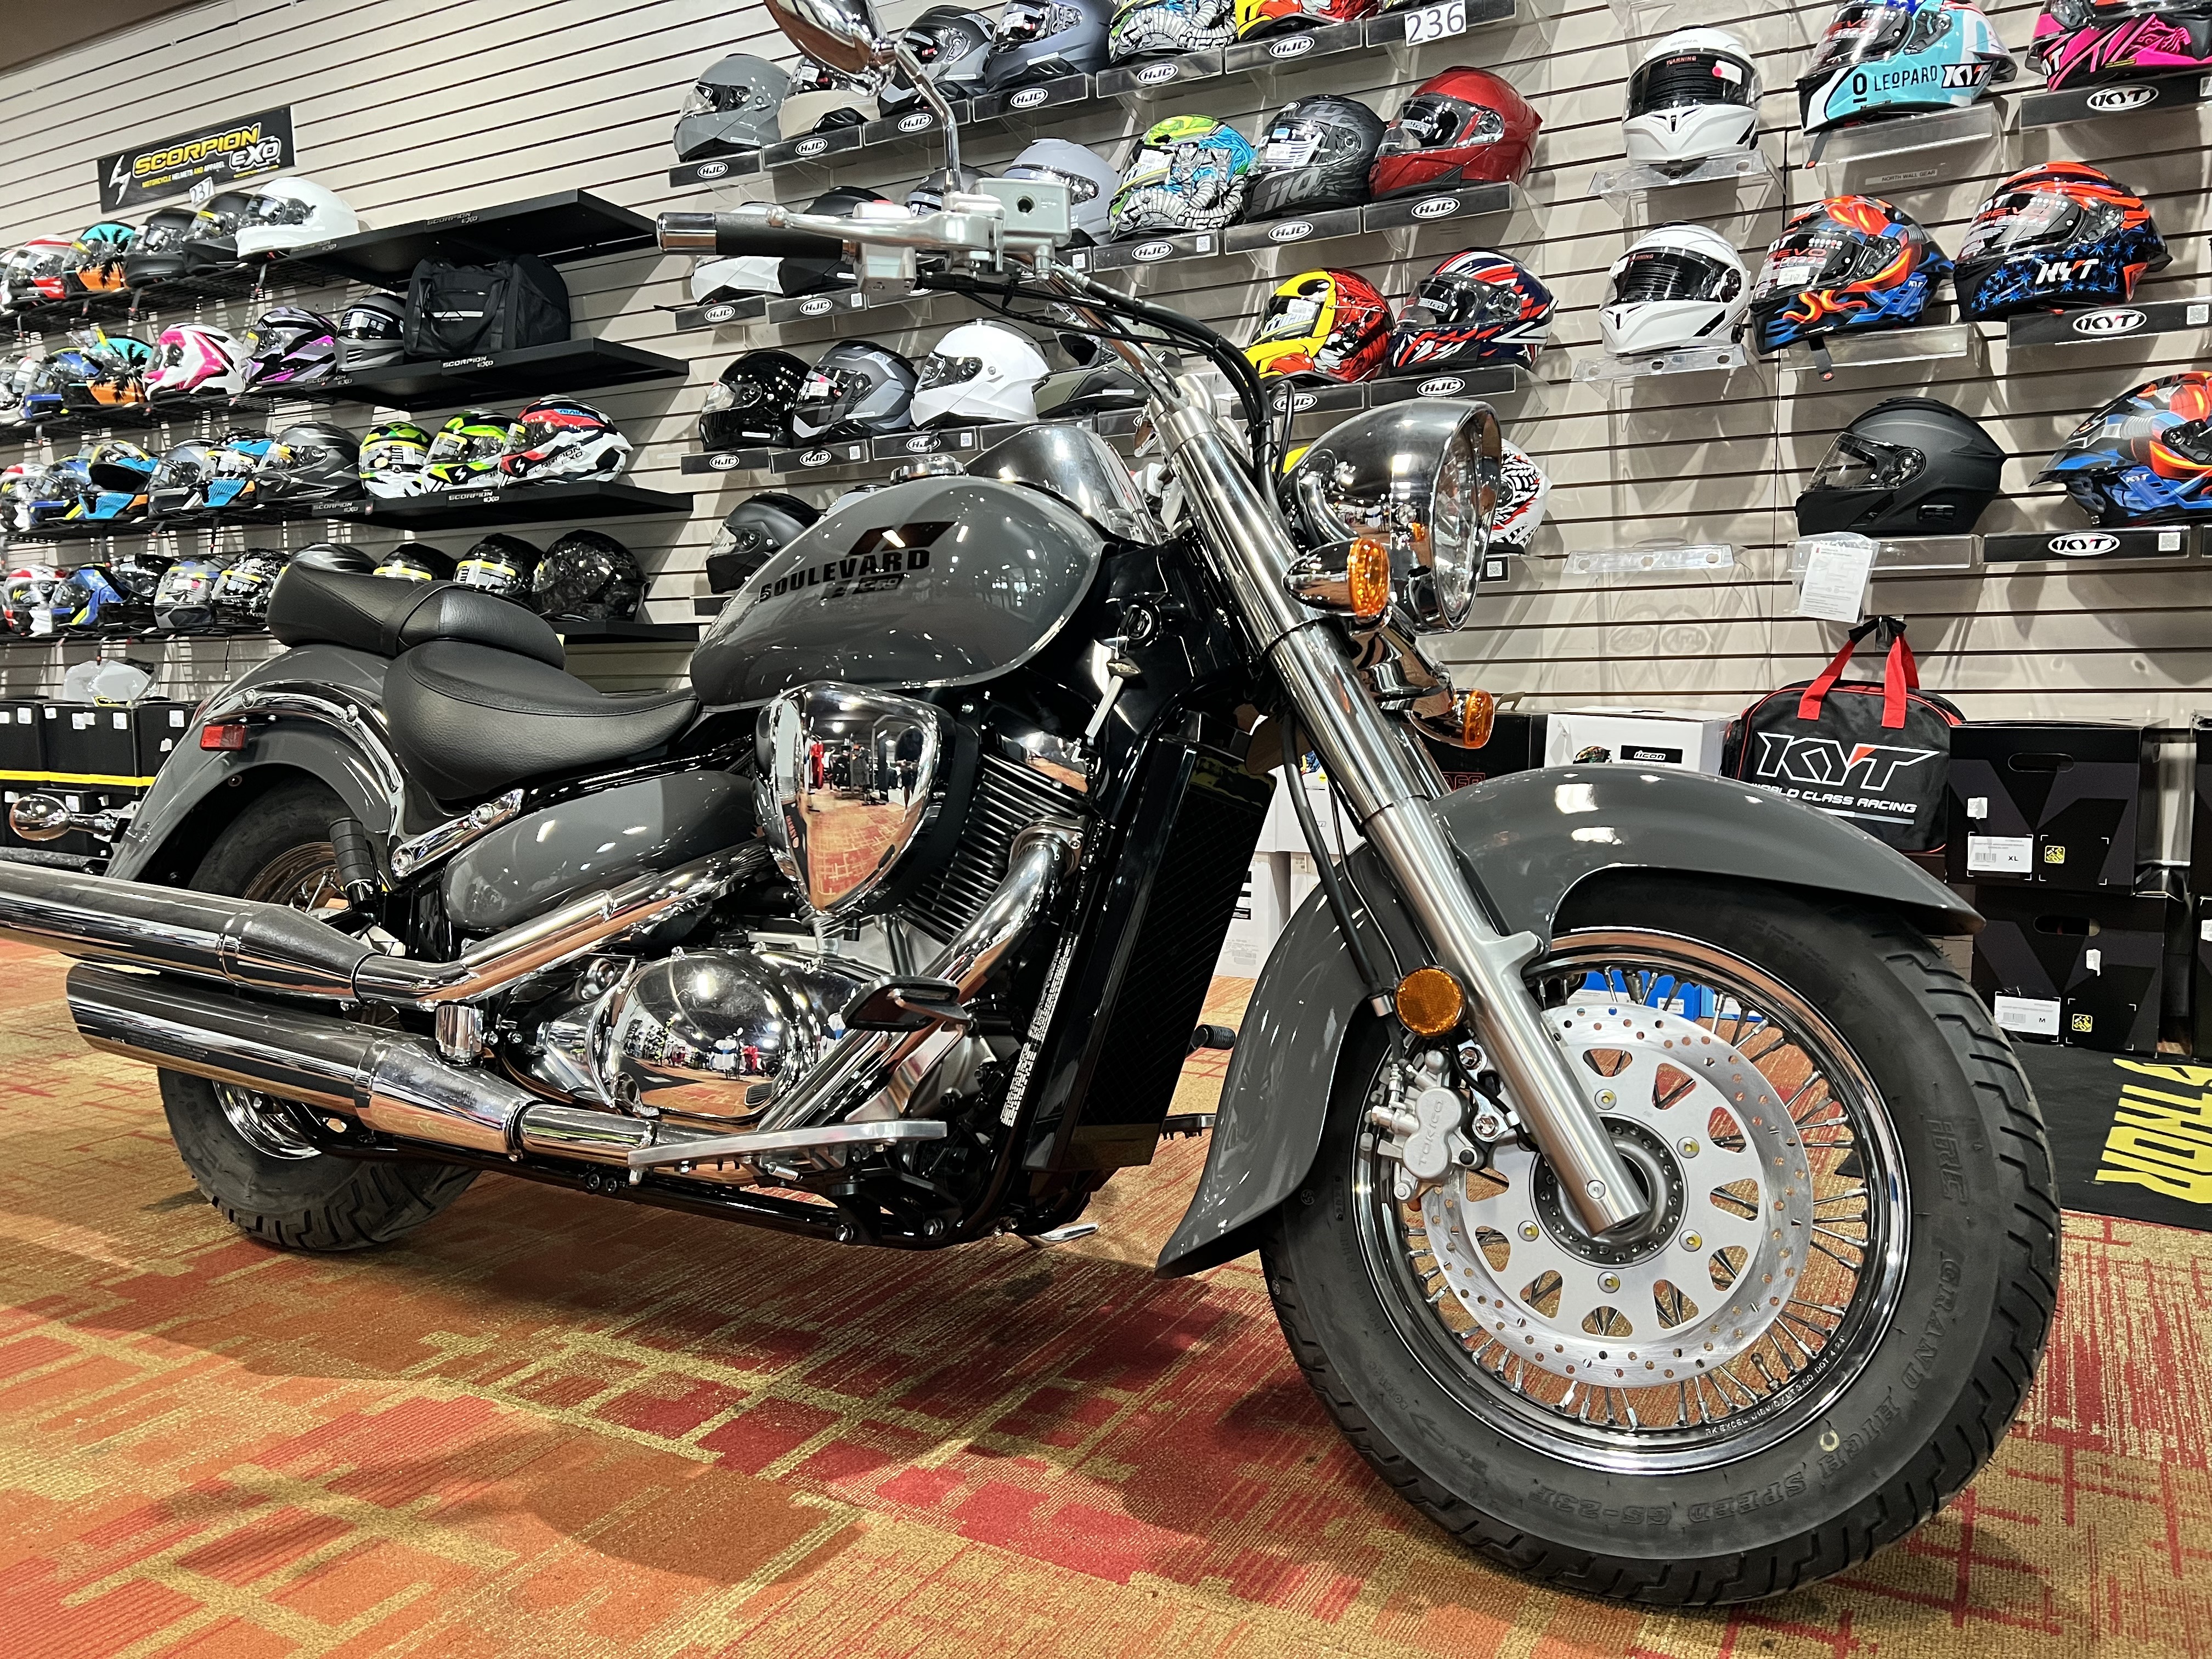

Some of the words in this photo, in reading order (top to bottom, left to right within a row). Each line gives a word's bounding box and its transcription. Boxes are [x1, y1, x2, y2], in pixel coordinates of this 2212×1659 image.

[1406, 2, 1465, 44] 236
[1274, 39, 1310, 54] HJC
[1666, 55, 1697, 66] WARNING
[1142, 66, 1173, 81] HJC
[1874, 67, 1937, 92] LEOPARD
[1943, 64, 1991, 88] KYT
[1015, 92, 1043, 105] HJC
[2095, 87, 2151, 107] KYT
[901, 116, 930, 128] HJC
[133, 124, 260, 177] SCORPION
[230, 140, 281, 167] EXO
[799, 140, 825, 153] HJC
[142, 174, 172, 188] MOTORCYCLE
[172, 168, 194, 181] HELMETS
[701, 164, 725, 177] HJC
[192, 182, 213, 205] 237
[1417, 200, 1455, 215] HJC
[426, 211, 472, 225] SCORPION
[1273, 224, 1310, 238] HJC
[1137, 245, 1169, 257] HJC
[2035, 258, 2100, 285] KYT
[708, 308, 732, 320] HJC
[804, 301, 830, 312] HJC
[2084, 313, 2138, 331] KYT
[442, 355, 488, 368] SCORPION
[477, 359, 494, 369] EXO
[1421, 379, 1460, 393] HJC
[713, 456, 736, 467] HJC
[803, 452, 828, 465] HJC
[448, 491, 493, 501] SCORPION
[313, 501, 353, 510] SCORPION
[2054, 537, 2112, 552] KYT
[1756, 731, 1940, 792] KYT
[1752, 783, 1800, 799] ORLD
[1802, 790, 1854, 806] CLASS
[1857, 798, 1918, 814] RACING
[1418, 1099, 1444, 1166] TOKICO
[1904, 1254, 1967, 1393] GRAND
[1705, 1426, 1718, 1436] RK
[1719, 1417, 1749, 1432] EXCEL
[1814, 1358, 1830, 1374] DOT
[1818, 1394, 1902, 1469] HIGH
[1528, 1483, 1673, 1527] GS-23F
[1688, 1472, 1808, 1523] SPEED
